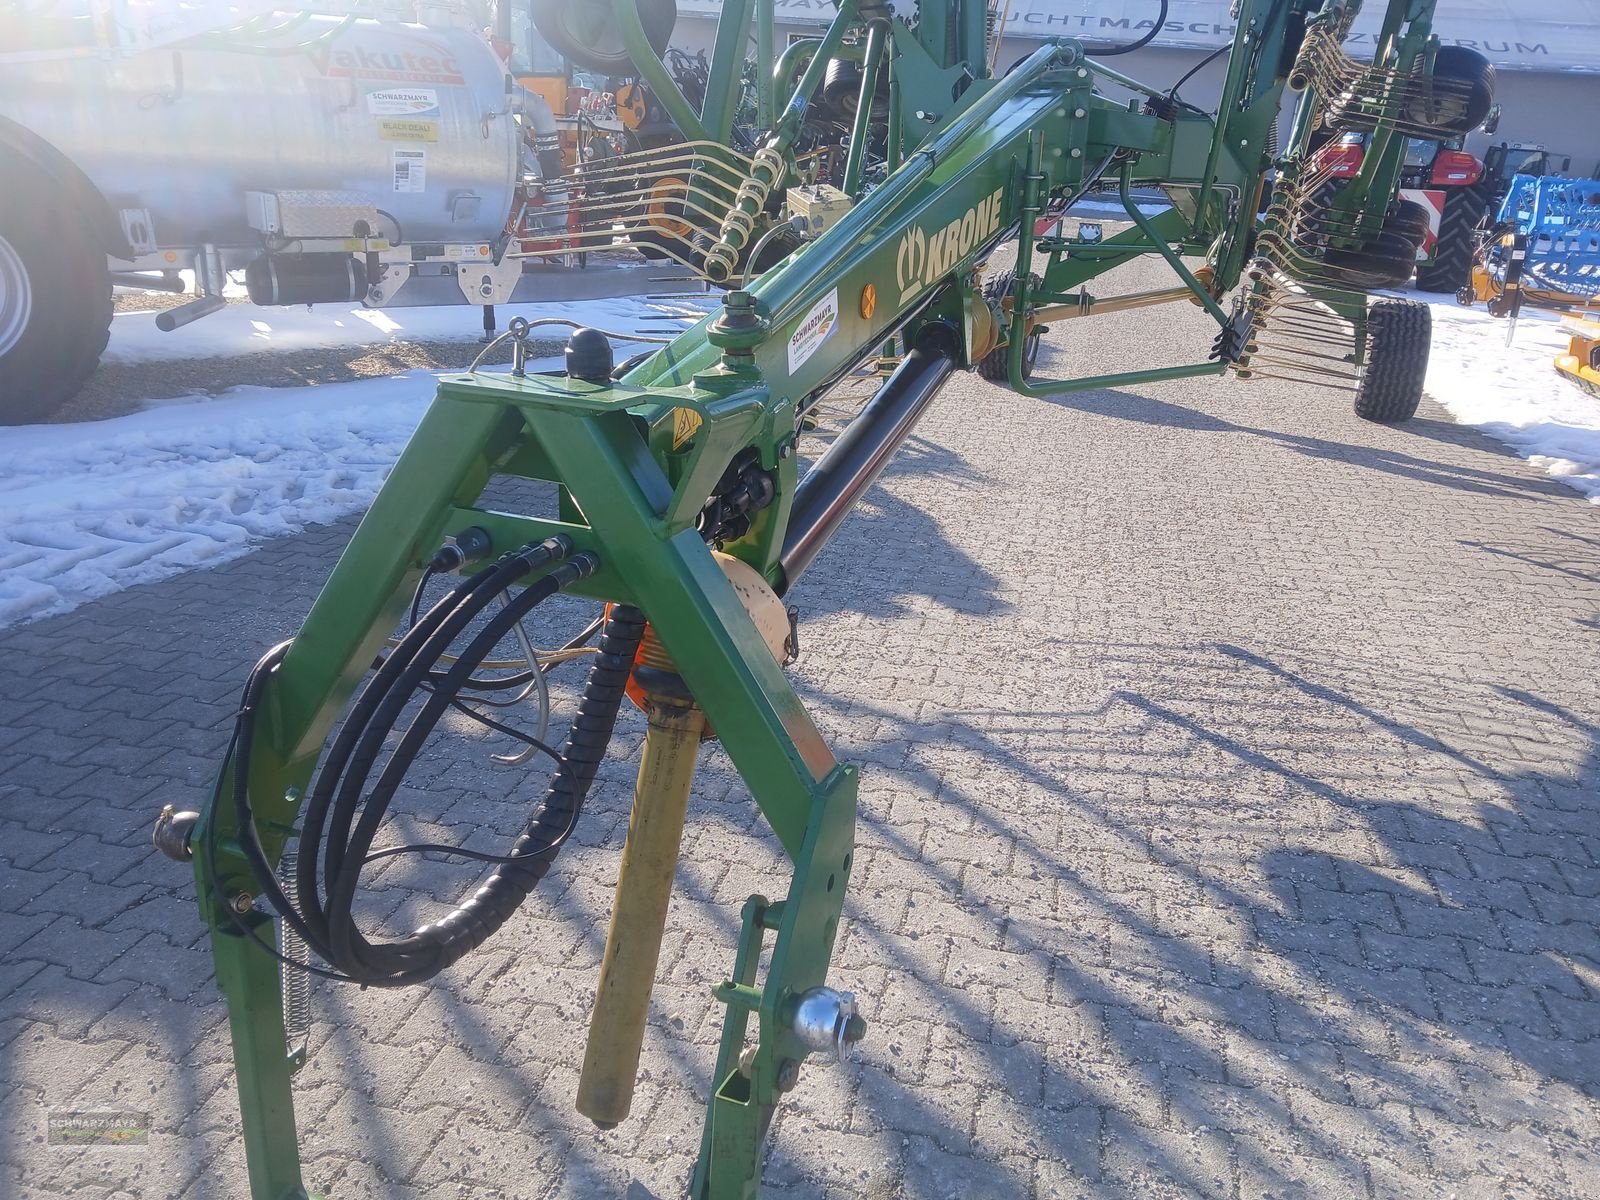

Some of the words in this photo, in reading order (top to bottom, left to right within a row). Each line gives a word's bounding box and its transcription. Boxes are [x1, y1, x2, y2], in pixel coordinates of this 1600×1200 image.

[372, 93, 428, 101] SCHWARZMAYR
[925, 186, 1003, 286] KRONE
[792, 304, 832, 346] SCHWARZMAYR
